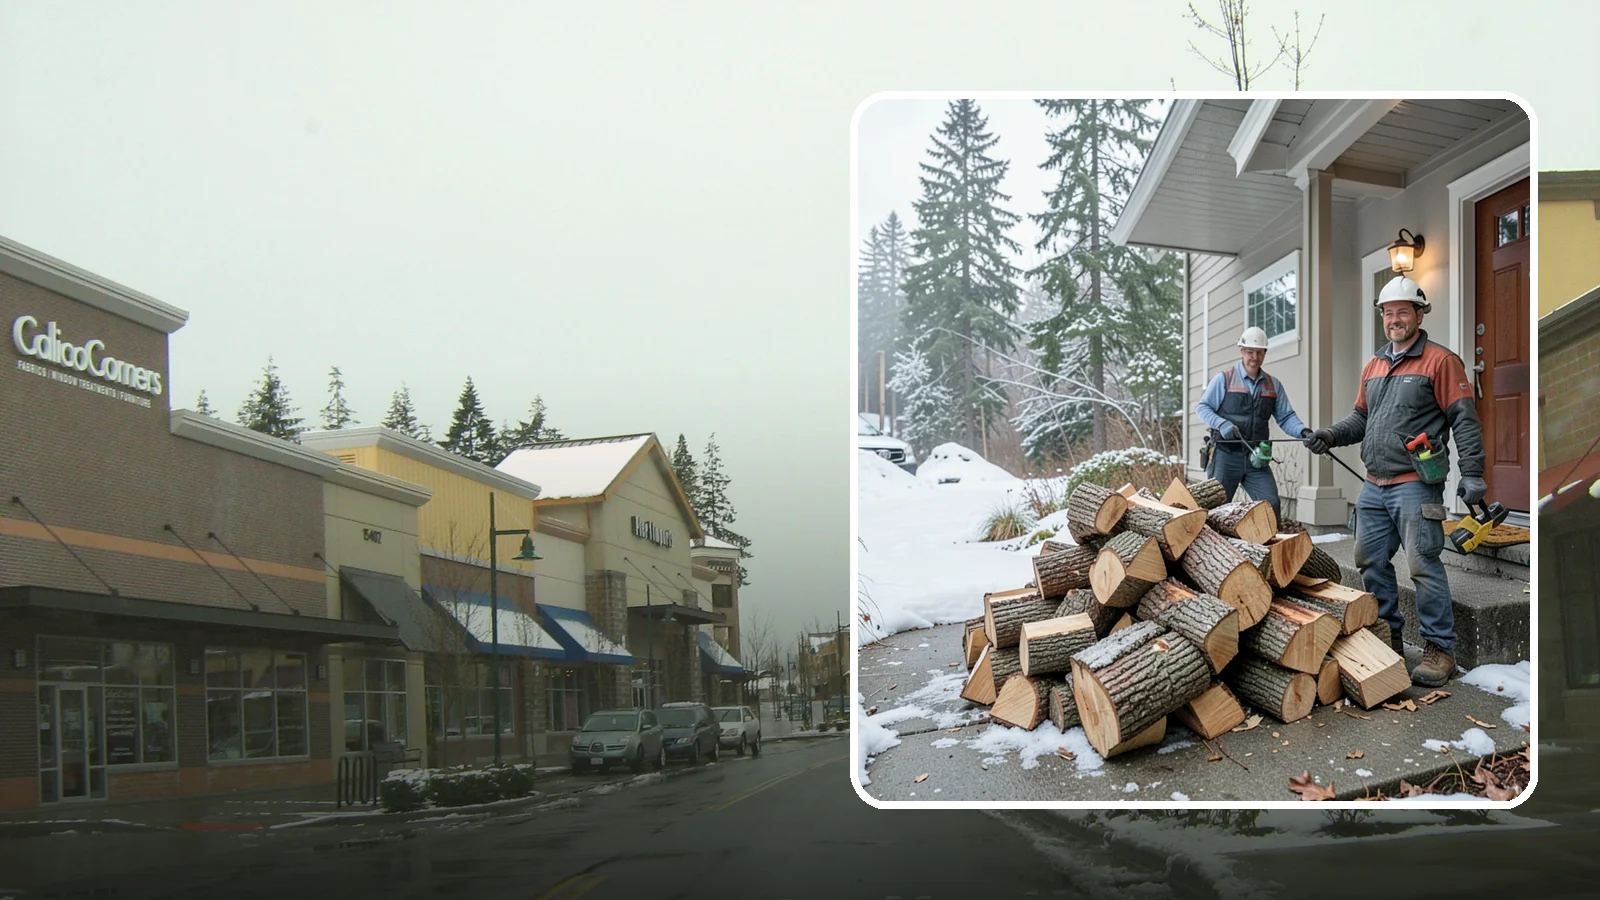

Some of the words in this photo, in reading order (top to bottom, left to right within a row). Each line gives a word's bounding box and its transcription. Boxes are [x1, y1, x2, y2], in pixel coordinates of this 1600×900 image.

[17, 360, 47, 377] FABRICS
[51, 369, 78, 386] WINDOW
[79, 379, 116, 398] TREATMENTS
[120, 391, 151, 408] FURNITURE
